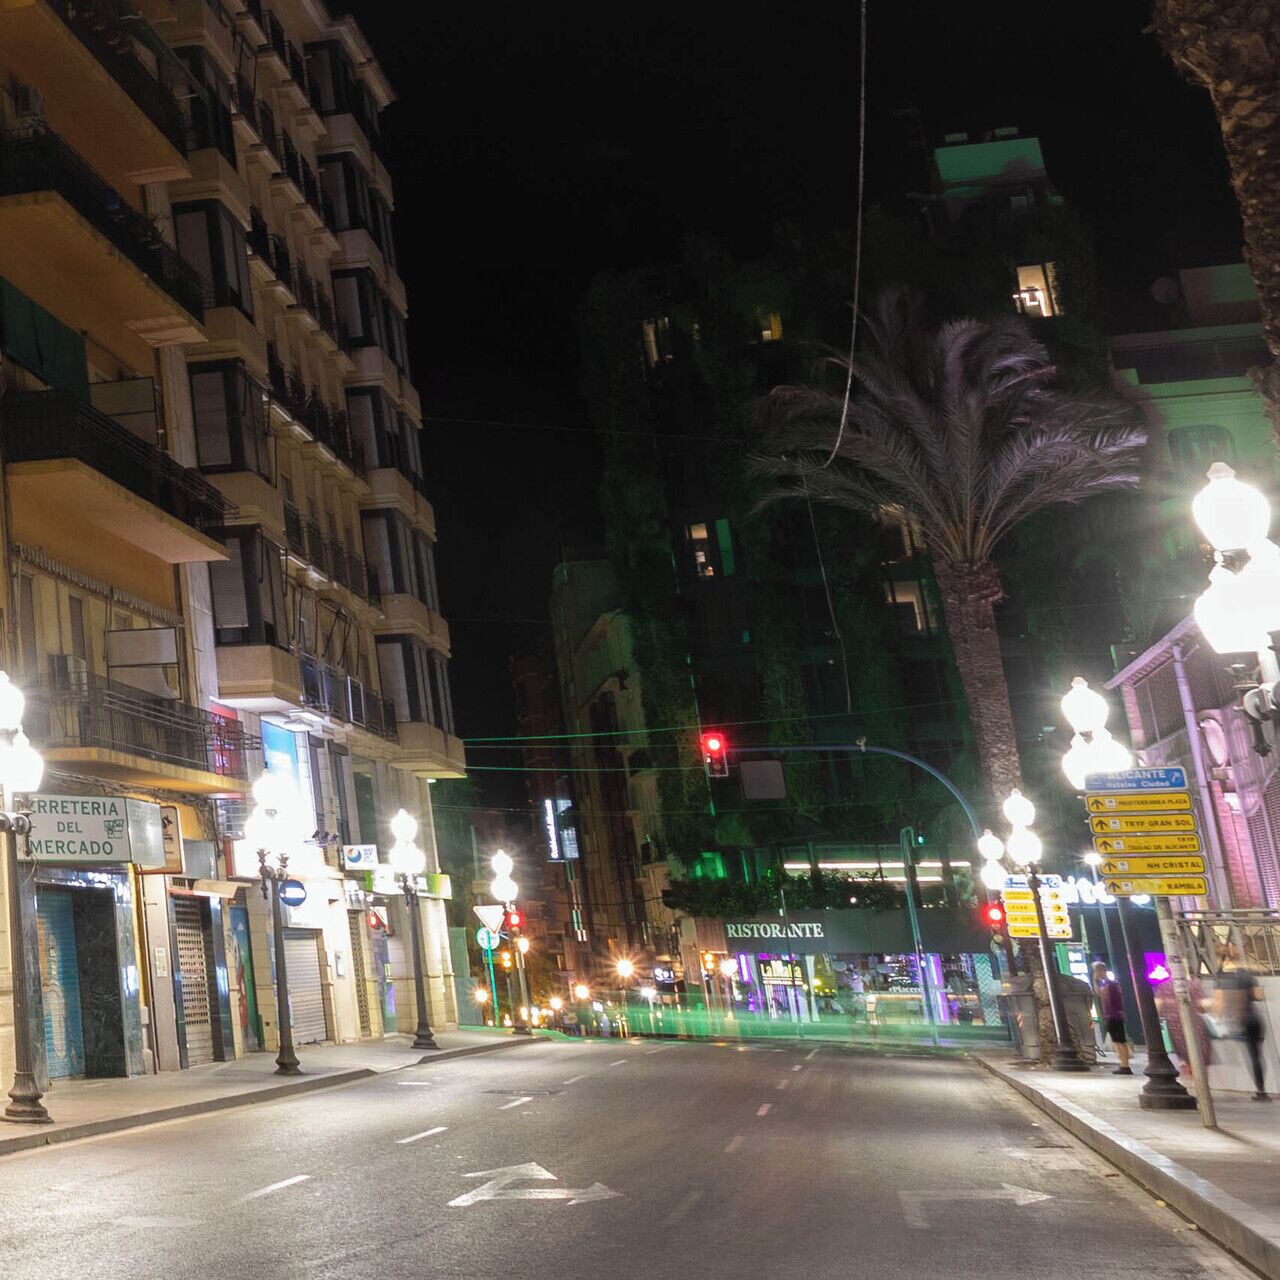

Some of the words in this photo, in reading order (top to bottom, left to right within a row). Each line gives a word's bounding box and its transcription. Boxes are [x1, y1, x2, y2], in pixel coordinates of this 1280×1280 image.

[1107, 769, 1167, 780] ALICANTE
[30, 799, 120, 817] RRETERIA
[57, 821, 83, 833] DEL
[1148, 819, 1172, 827] GRAN
[29, 839, 114, 856] MERCADO
[726, 922, 825, 939] RISTORANTE
